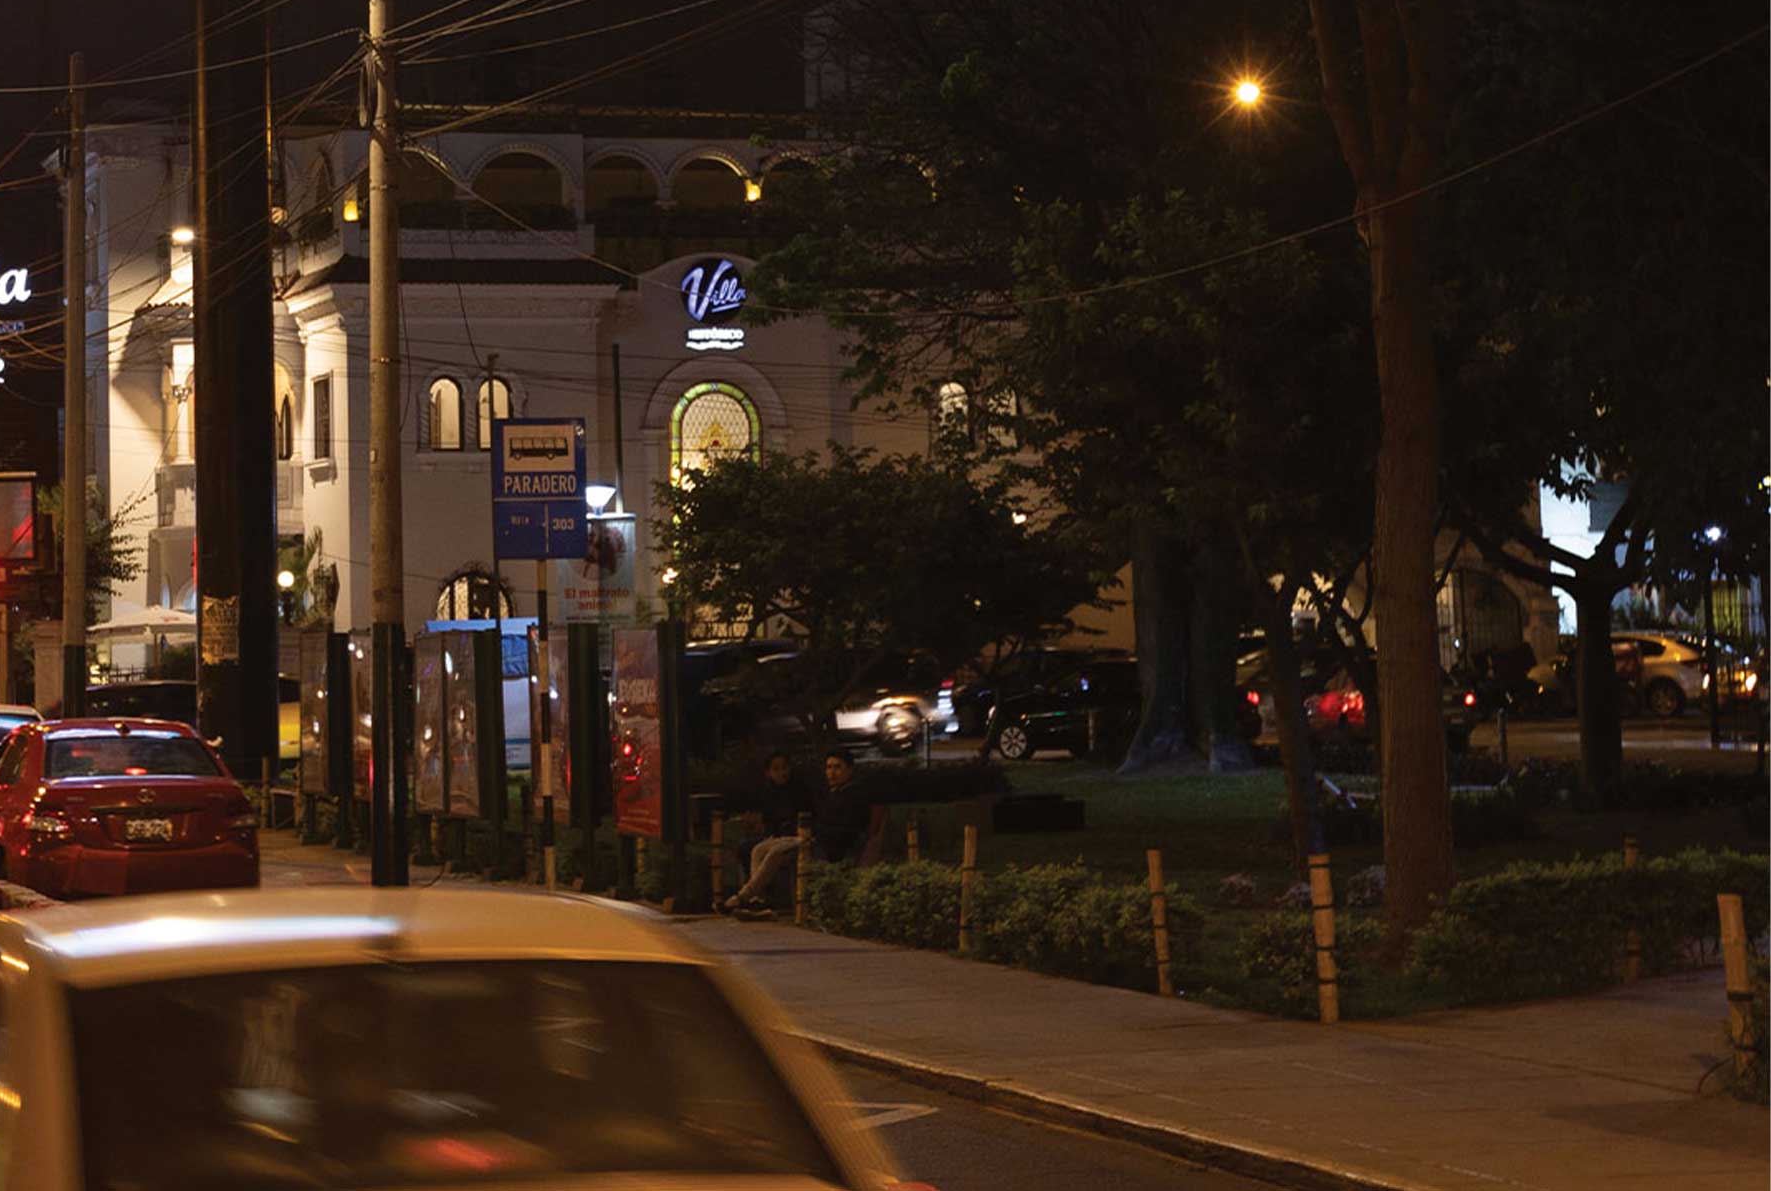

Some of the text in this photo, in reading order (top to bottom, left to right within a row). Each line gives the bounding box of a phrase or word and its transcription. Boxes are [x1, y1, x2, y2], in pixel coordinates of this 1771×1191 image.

[681, 259, 747, 322] Villa
[504, 474, 577, 494] PARADERO
[553, 518, 574, 530] 303
